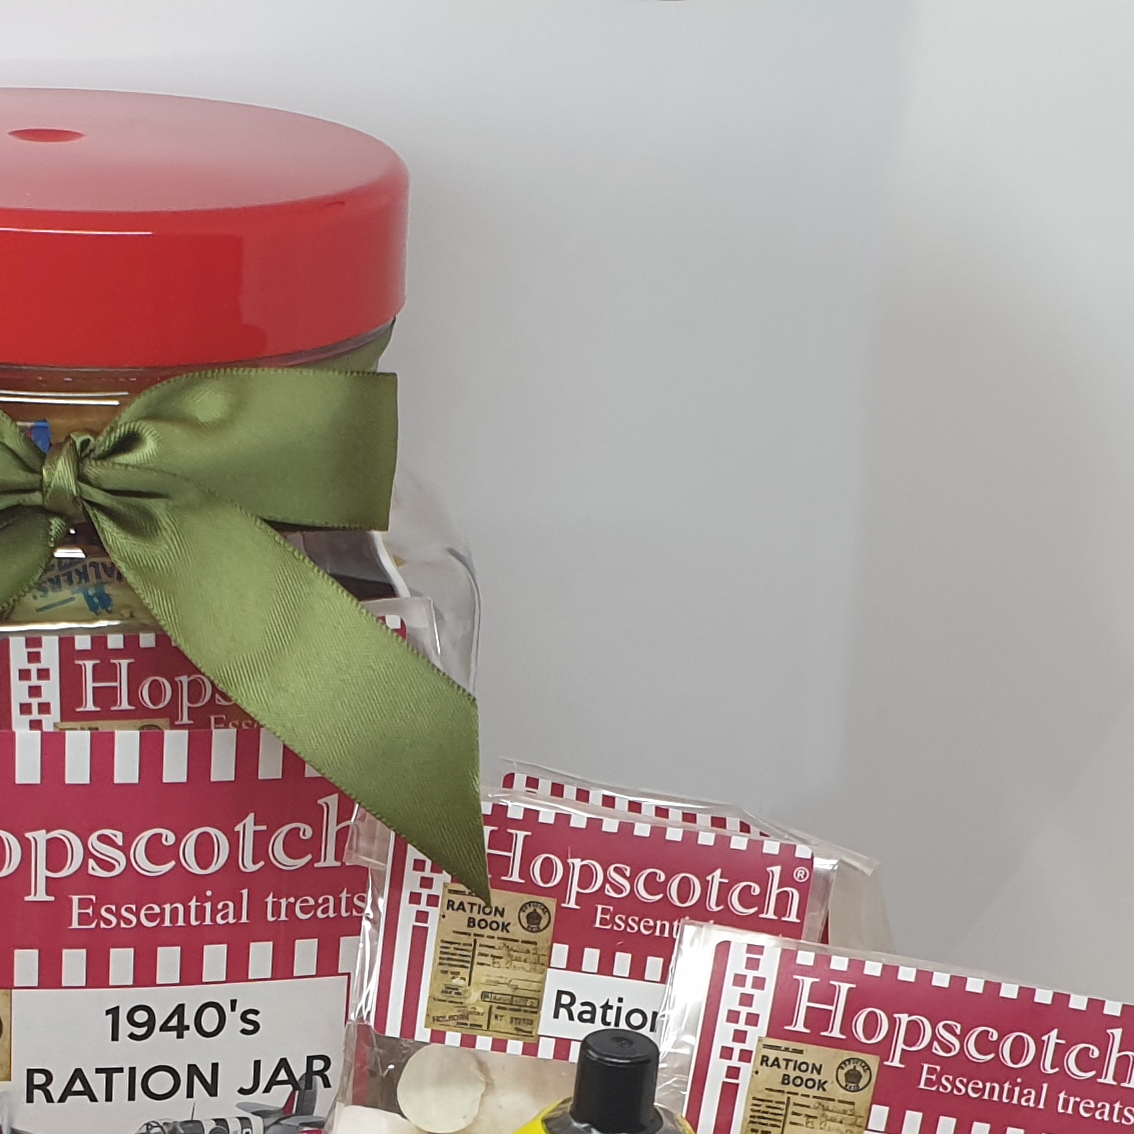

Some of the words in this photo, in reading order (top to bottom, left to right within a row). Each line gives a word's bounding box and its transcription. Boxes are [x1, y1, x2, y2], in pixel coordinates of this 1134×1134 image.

[68, 889, 251, 930] Essential
[264, 884, 369, 923] treats
[466, 916, 512, 934] BOOK
[104, 999, 262, 1042] 1940's
[784, 973, 1134, 1089] Hopscotch
[25, 1061, 220, 1105] RATION
[237, 1054, 333, 1096] JAR
[759, 1054, 824, 1076] RATION
[780, 1073, 829, 1093] BOOK
[917, 1062, 1047, 1110] Essential
[1056, 1088, 1134, 1127] treats
